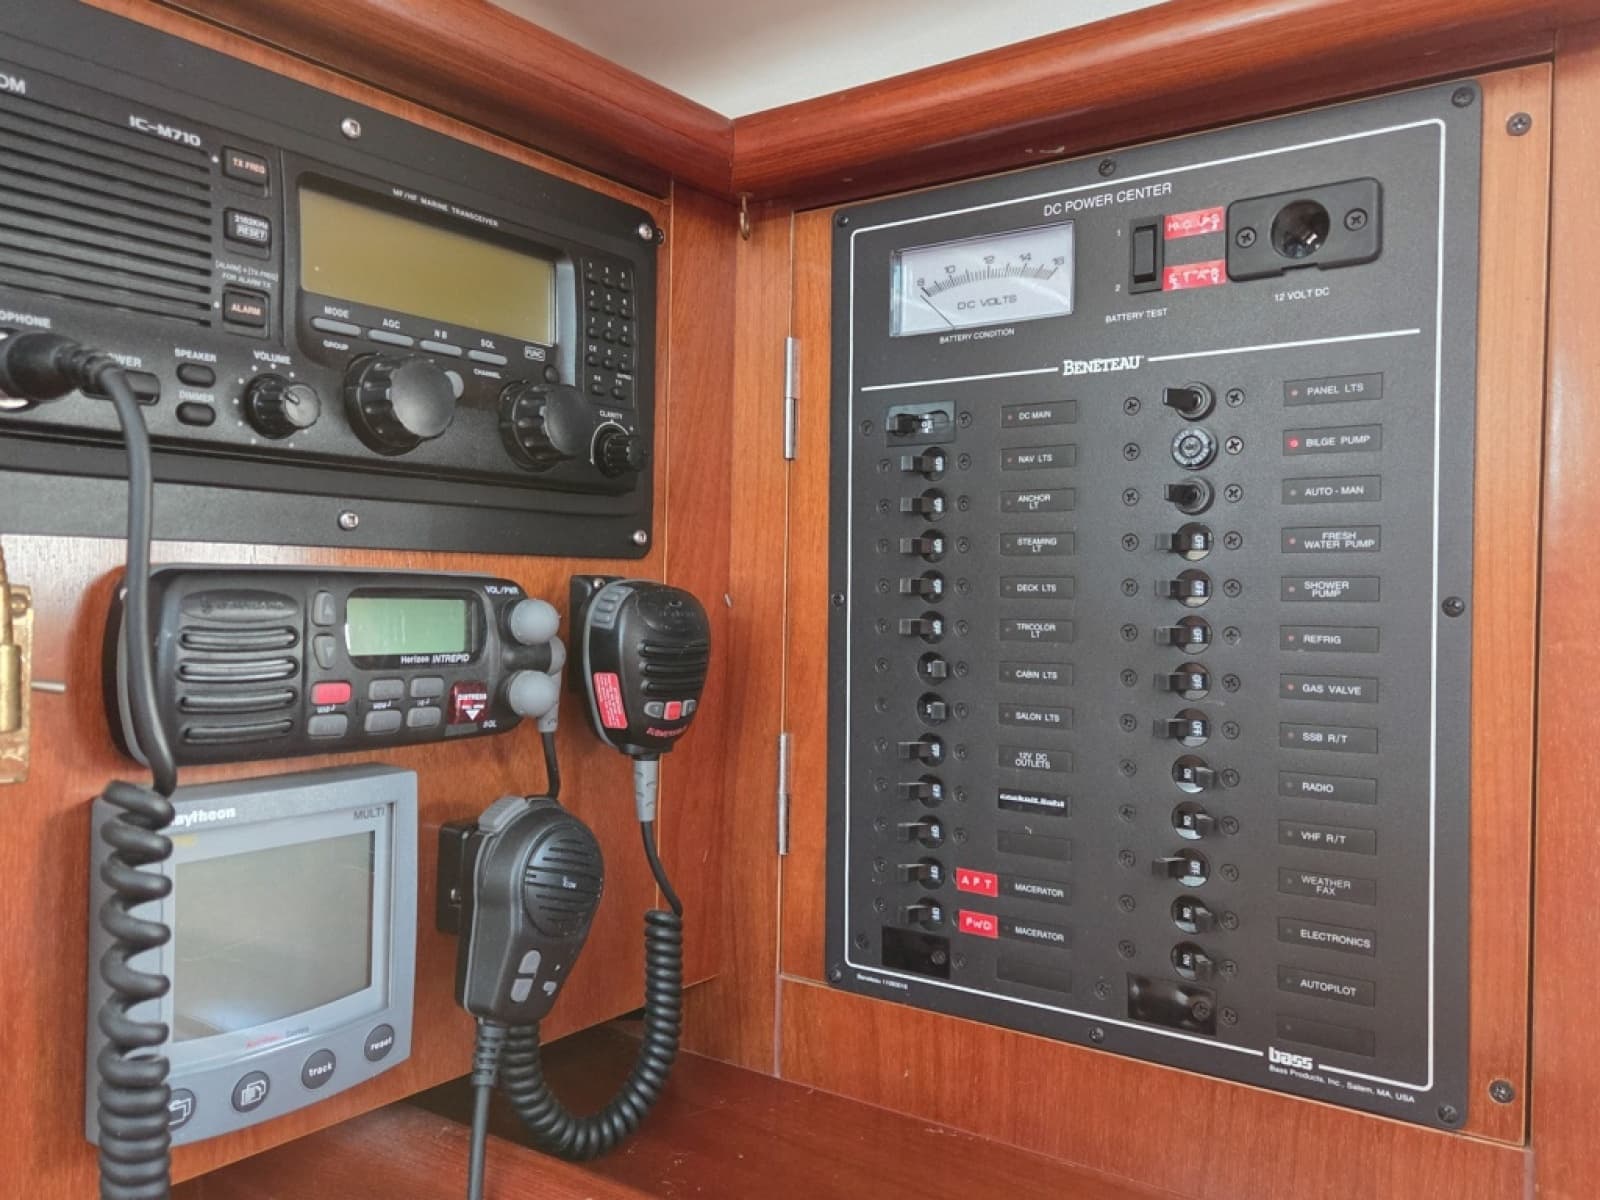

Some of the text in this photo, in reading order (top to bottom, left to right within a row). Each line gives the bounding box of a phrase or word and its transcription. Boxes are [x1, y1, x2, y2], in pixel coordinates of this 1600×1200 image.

[129, 115, 200, 147] IC-M710
[1044, 182, 1173, 217] DC POWER CENTER
[984, 255, 996, 265] 12
[1019, 252, 1032, 262] 14
[1275, 286, 1330, 301] 12 VOLT DC
[957, 294, 1017, 311] DC VOLTS
[325, 304, 349, 319] MODE
[1105, 308, 1168, 323] BATTERY TEST
[383, 318, 400, 329] AGC
[939, 327, 1015, 345] BATTERY CONDITION
[175, 349, 217, 363] SPEAKER
[253, 350, 291, 365] VOLUME
[1063, 356, 1141, 376] BENETEAU
[1307, 383, 1364, 396] PANEL LTS
[179, 390, 215, 403] DIMMER
[1019, 411, 1051, 420] DC MAIN
[1306, 434, 1370, 448] BILGE PUMP
[1018, 454, 1053, 463] NAV LTS
[1018, 494, 1051, 502] ANCHOR
[1029, 502, 1038, 510] LT
[1017, 538, 1056, 546] STEAMING
[1322, 532, 1356, 540] FRESH
[1304, 539, 1375, 549] WATER PUMP
[1017, 584, 1056, 592] DECK LTS
[1304, 581, 1349, 590] SHOWER
[1312, 589, 1341, 598] PUMP
[1016, 623, 1056, 631] TRICOLOR
[1030, 631, 1040, 639] LT
[1303, 634, 1341, 645] REFRIG
[401, 653, 470, 664] Horizon INTREPID
[1016, 671, 1057, 679] CABIN LTS
[1302, 683, 1361, 696] GAS VALVE
[1016, 712, 1059, 722] SALON LTS
[1302, 732, 1348, 744] SSB R/T
[1019, 752, 1047, 761] 12V DC
[1015, 759, 1050, 769] OUTLETS
[1302, 782, 1333, 793] RADIO
[171, 807, 236, 827] aytheon
[353, 807, 385, 820] MULTI
[1301, 831, 1347, 844] VHF R/T
[1301, 875, 1351, 889] WEATHER
[1015, 883, 1064, 898] MACERATOR
[1317, 886, 1336, 896] FAX
[1015, 926, 1064, 942] MACERATOR
[1300, 929, 1370, 948] ELECTRONICS
[1300, 978, 1357, 997] AUTOPILOT
[370, 1036, 392, 1050] reset
[1268, 1046, 1313, 1071] bass
[309, 1062, 332, 1077] track
[1269, 1064, 1288, 1075] Bass
[1395, 1092, 1415, 1103] USA
